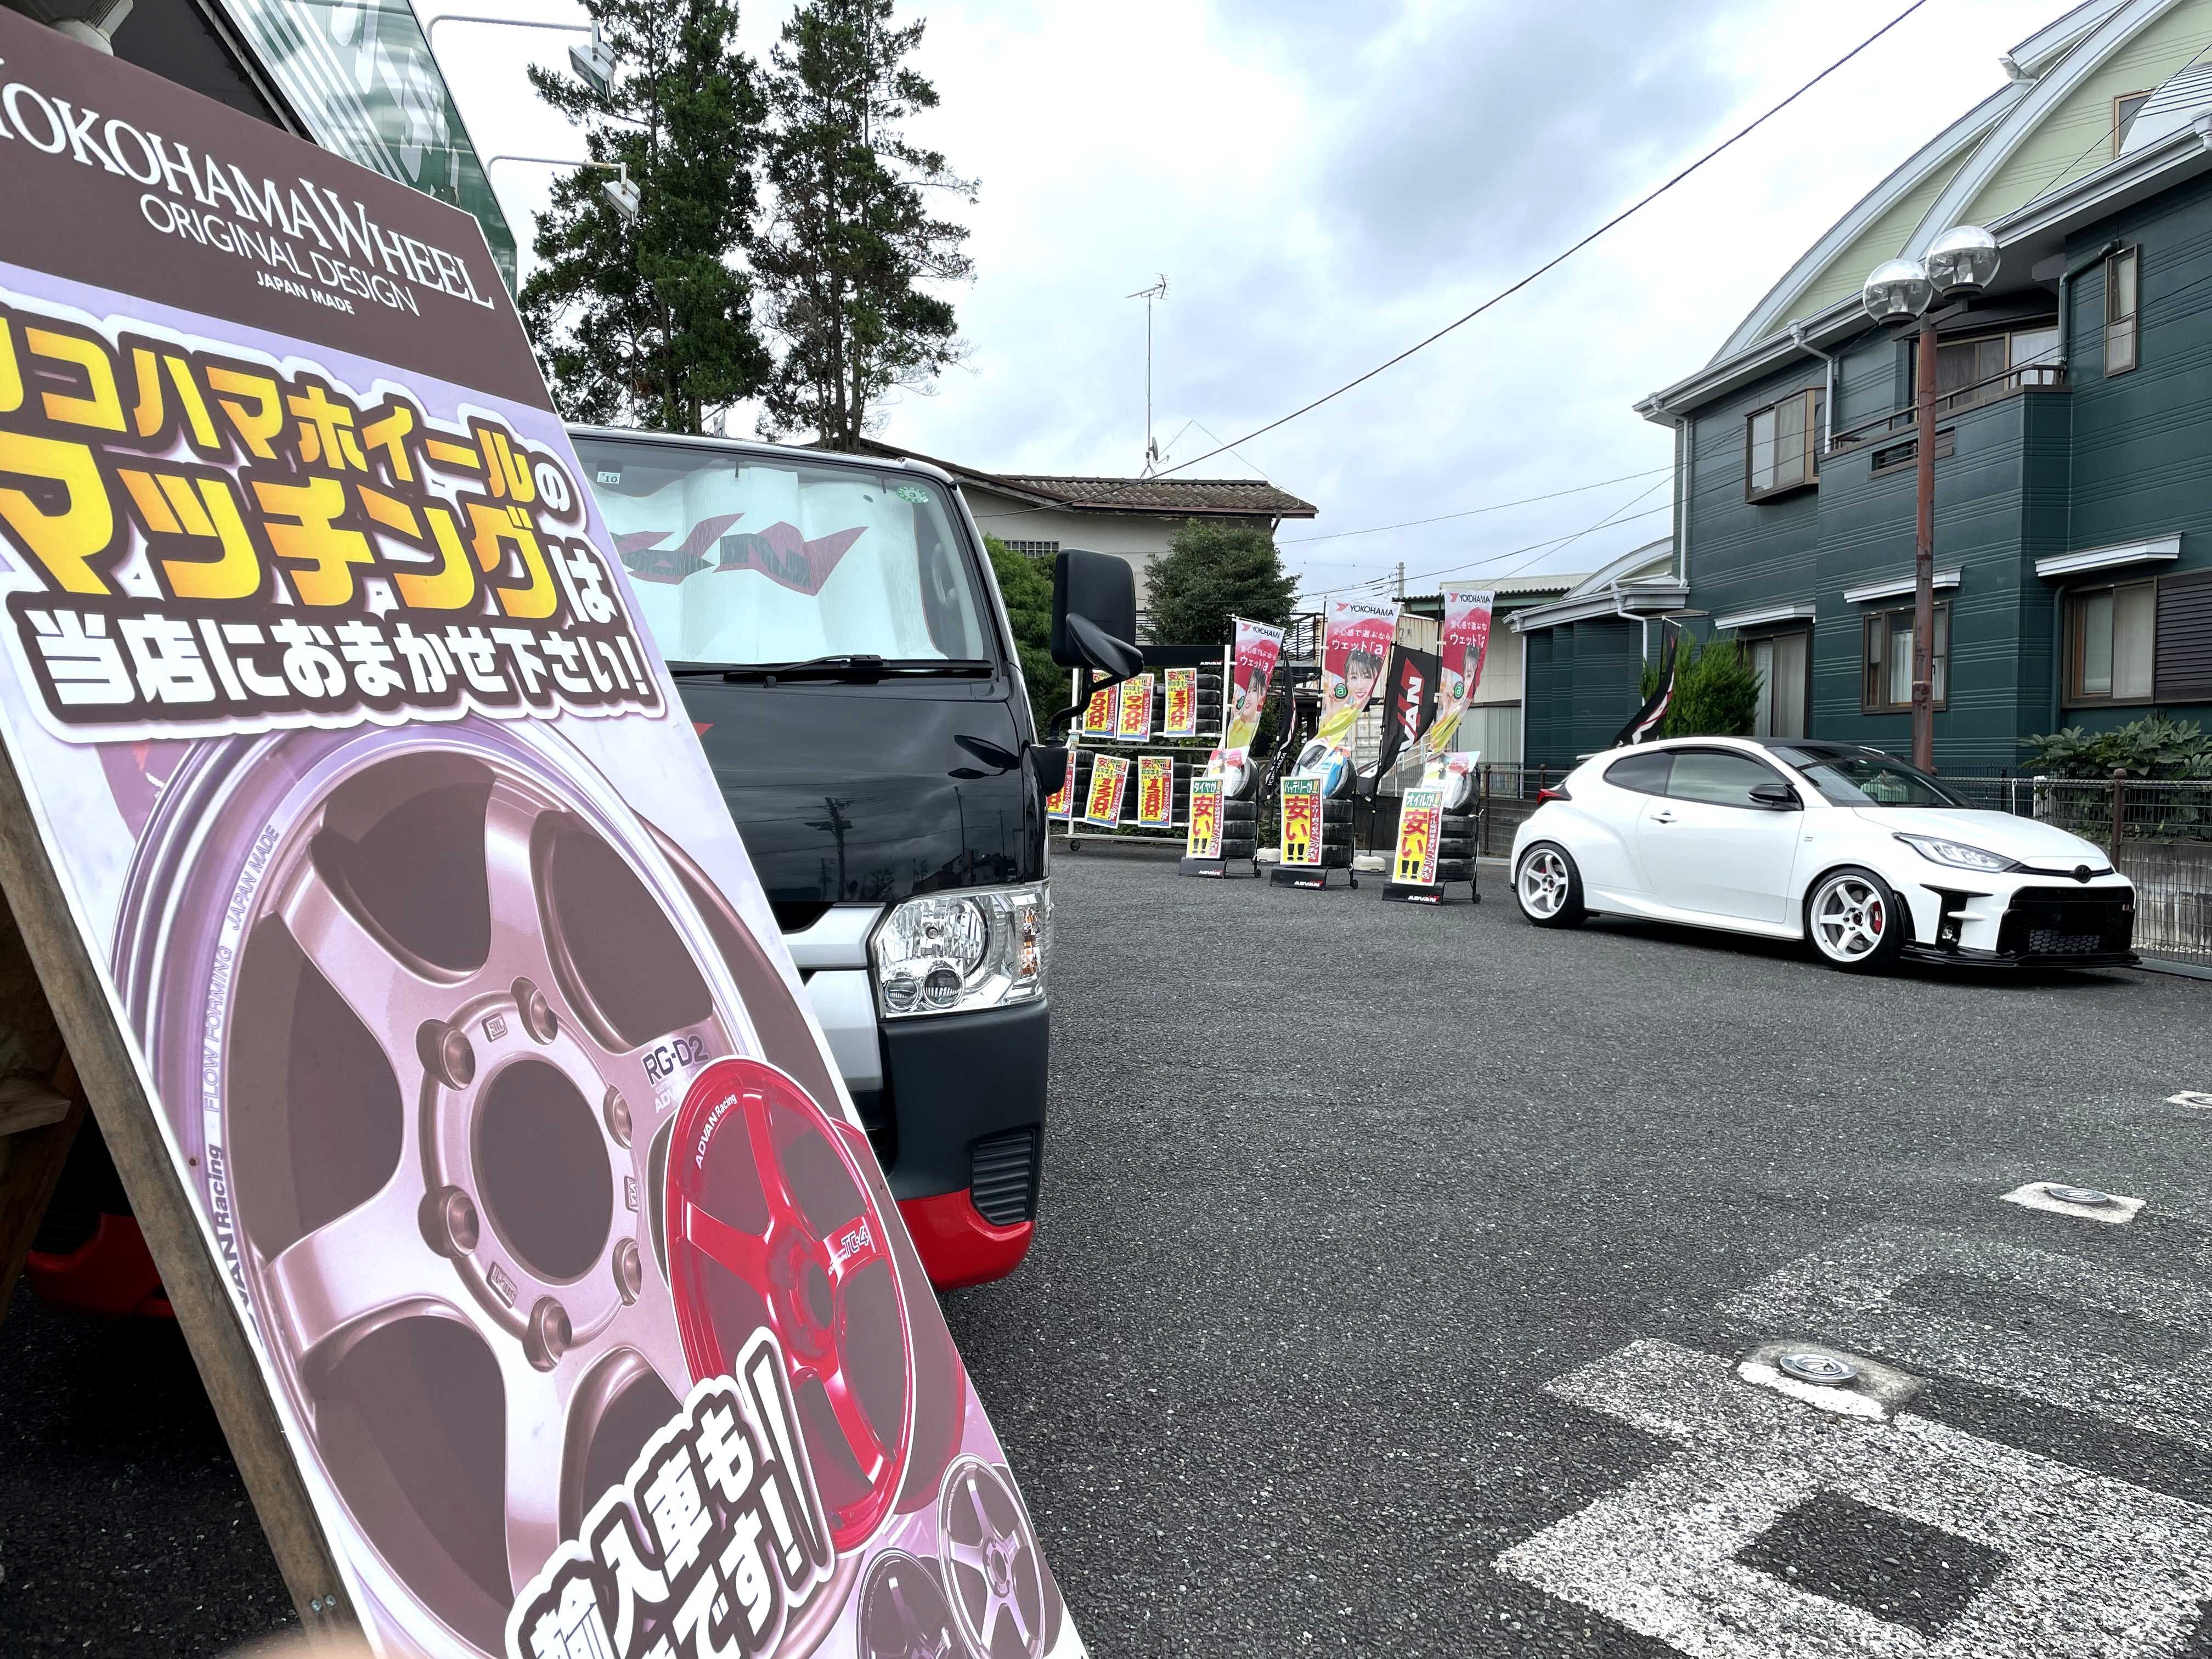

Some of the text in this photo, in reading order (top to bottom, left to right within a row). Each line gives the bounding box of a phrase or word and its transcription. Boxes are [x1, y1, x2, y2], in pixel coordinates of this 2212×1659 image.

[0, 58, 332, 250] OKOHAMA
[140, 193, 421, 317] ORIGINAL DESIGN
[256, 270, 356, 315] JAPAN MADE
[0, 431, 618, 625] マッチングは
[1350, 605, 1394, 617] YOKOHAMA
[1459, 594, 1491, 604] YOKOHAMA
[24, 610, 643, 705] 当店におまかせ下さい!
[224, 825, 281, 930] JAPAN MADE
[204, 946, 233, 1113] FLOW FORMING
[695, 1093, 737, 1170] ADVAN Racing
[208, 1143, 234, 1229] Racing
